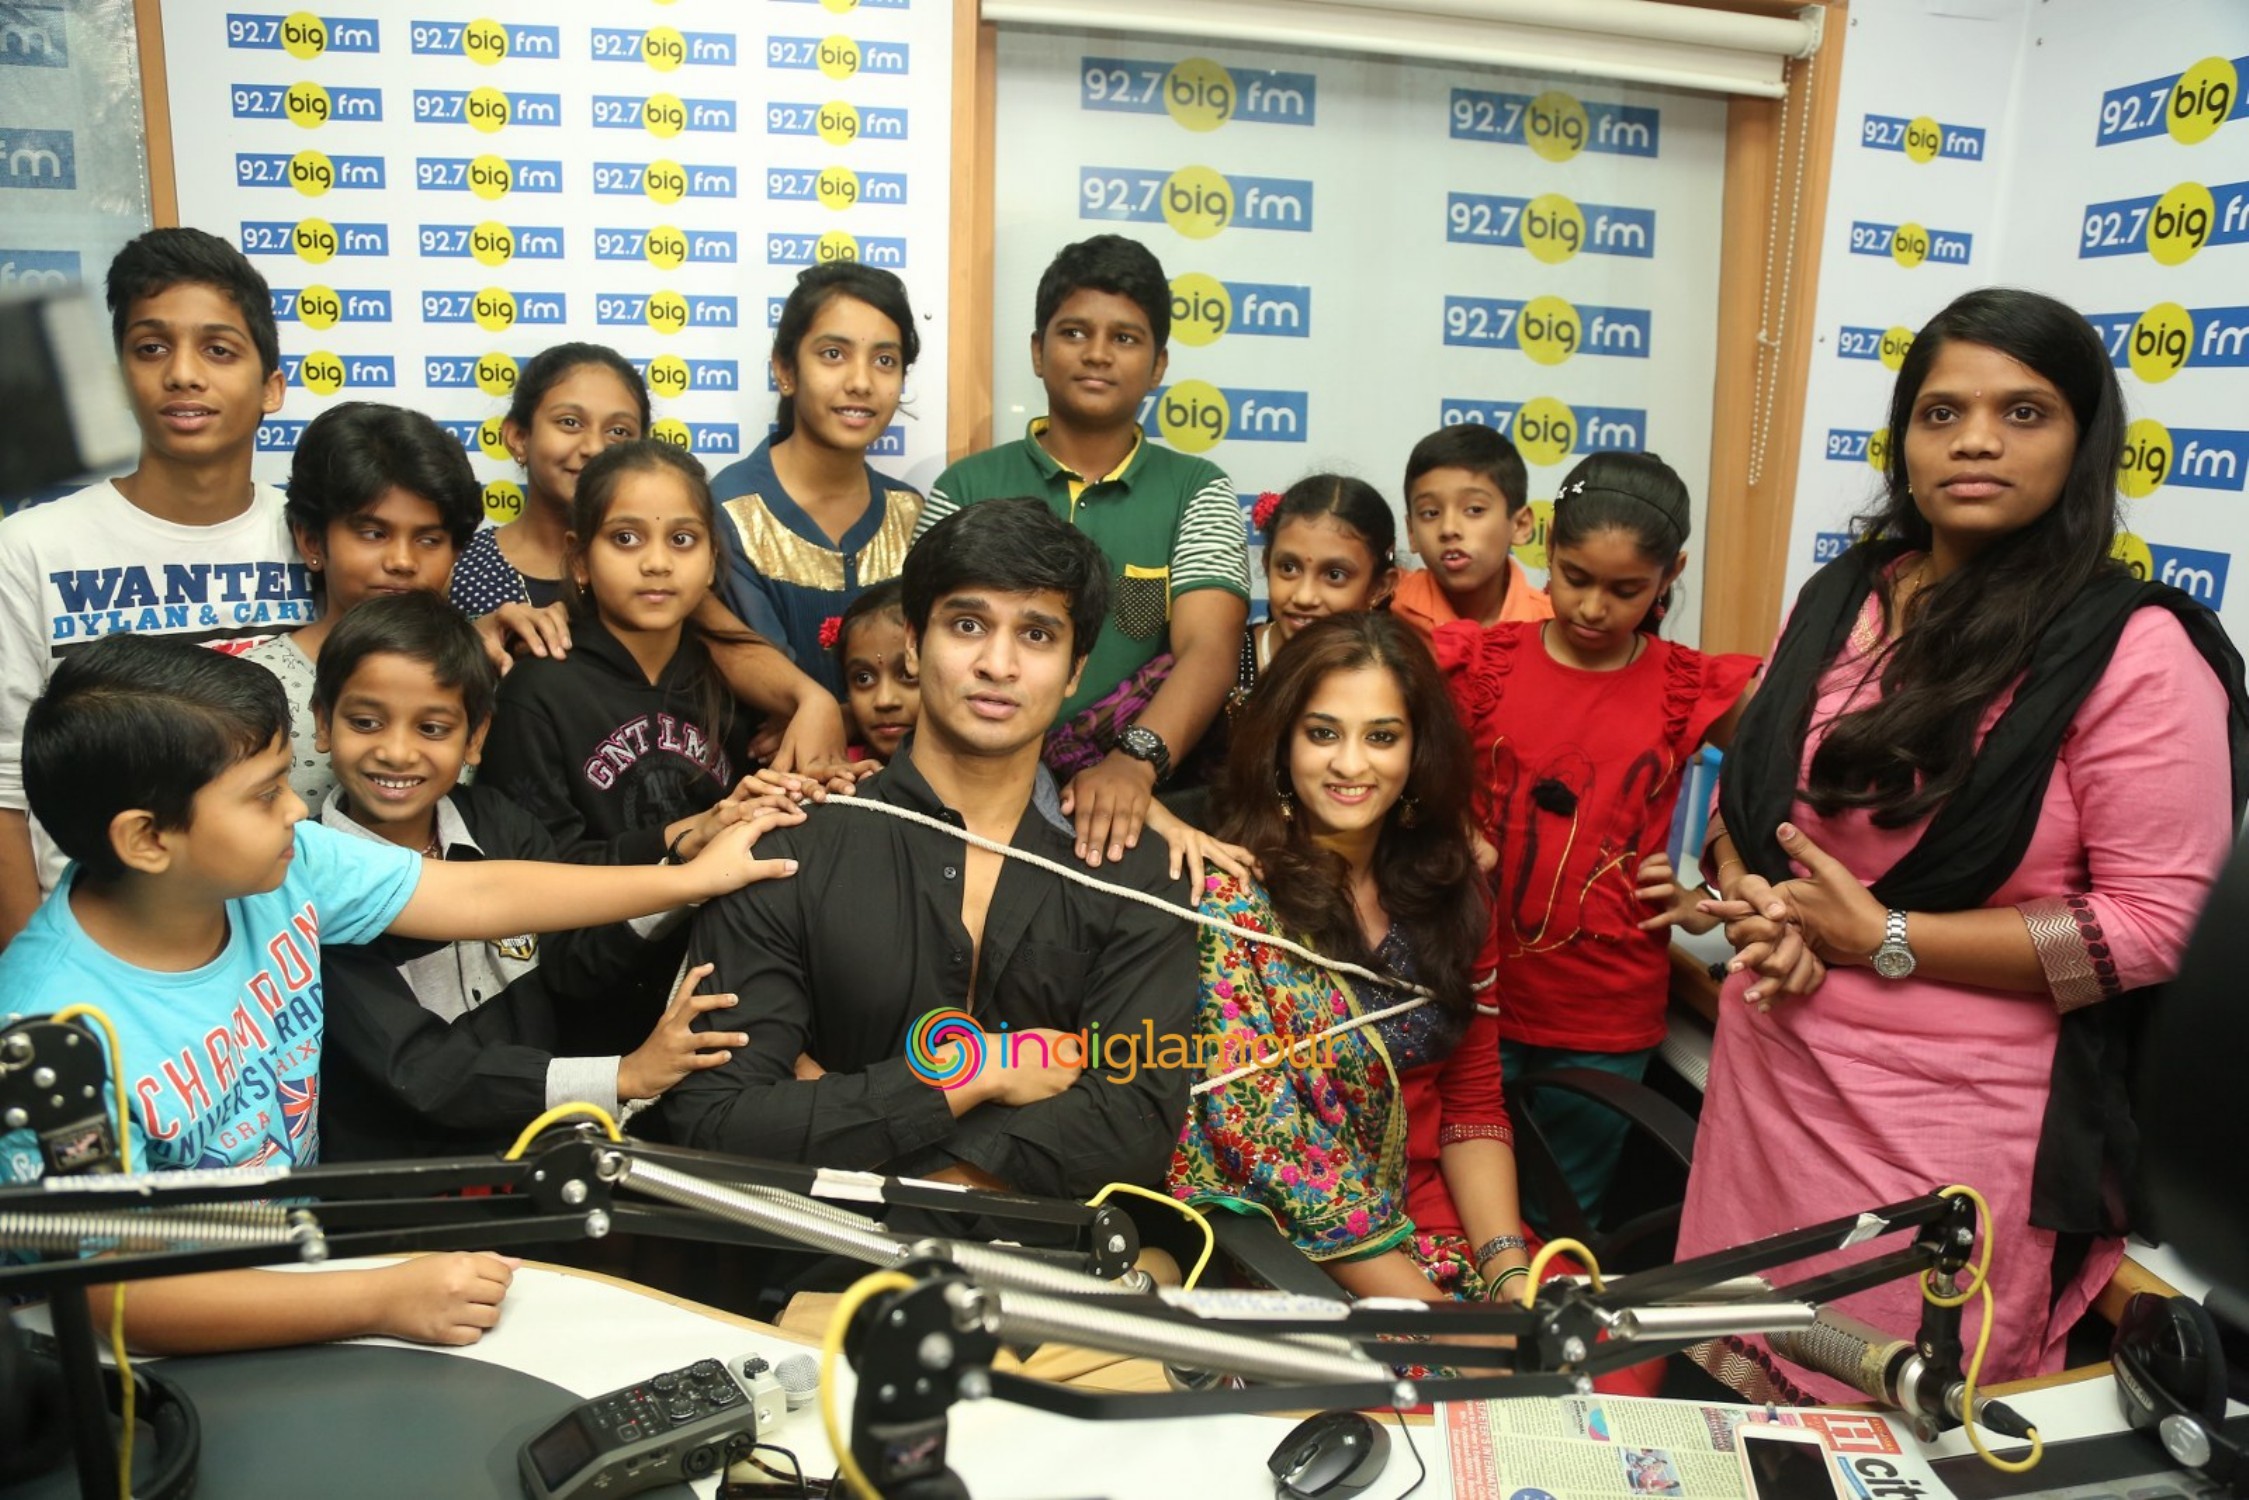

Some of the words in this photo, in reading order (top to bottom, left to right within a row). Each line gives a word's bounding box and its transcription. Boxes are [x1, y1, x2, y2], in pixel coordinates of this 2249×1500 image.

[231, 21, 281, 42] 92.7
[285, 23, 323, 51] big
[335, 25, 372, 45] fm
[414, 28, 462, 48] 92.7
[468, 30, 504, 56] big
[515, 32, 552, 52] fm
[594, 34, 640, 55] 92.7
[647, 38, 681, 63] big
[693, 39, 730, 59] fm
[770, 41, 815, 64] 92.7
[822, 47, 855, 71] big
[868, 48, 902, 67] fm
[236, 91, 284, 112] 92.7
[289, 93, 327, 120] big
[338, 94, 375, 114] fm
[1086, 69, 1161, 103] 92.7
[1172, 74, 1229, 119] big
[1248, 81, 1304, 115] fm
[2103, 88, 2169, 135] 92.7
[2174, 80, 2229, 124] big
[417, 96, 464, 117] 92.7
[470, 98, 506, 124] big
[517, 100, 554, 120] fm
[595, 102, 641, 122] 92.7
[648, 105, 682, 130] big
[694, 106, 730, 126] fm
[770, 108, 814, 130] 92.7
[822, 113, 855, 137] big
[866, 113, 901, 133] fm
[1454, 98, 1523, 133] 92.7
[1532, 107, 1582, 150] big
[1598, 113, 1649, 147] fm
[1865, 121, 1905, 144] 92.7
[1908, 127, 1938, 155] big
[1947, 132, 1979, 154] fm
[240, 160, 289, 180] 92.7
[293, 161, 330, 188] big
[341, 163, 378, 182] fm
[419, 164, 467, 184] 92.7
[472, 166, 508, 191] big
[519, 167, 556, 186] fm
[596, 169, 643, 189] 92.7
[649, 171, 683, 196] big
[694, 172, 730, 191] fm
[770, 173, 814, 195] 92.7
[821, 178, 854, 202] big
[866, 178, 900, 198] fm
[1083, 178, 1160, 212] 92.7
[1170, 182, 1227, 227] big
[1245, 187, 1301, 221] fm
[1451, 202, 1521, 236] 92.7
[1529, 210, 1578, 252] big
[1595, 215, 1645, 248] fm
[2085, 208, 2149, 248] 92.7
[2154, 203, 2207, 248] big
[245, 228, 293, 248] 92.7
[297, 229, 334, 255] big
[345, 230, 381, 249] fm
[422, 231, 469, 251] 92.7
[475, 233, 510, 258] big
[521, 233, 557, 252] fm
[597, 235, 643, 254] 92.7
[649, 237, 684, 261] big
[695, 238, 730, 256] fm
[769, 239, 814, 260] 92.7
[865, 243, 900, 263] fm
[1853, 228, 1892, 250] 92.7
[1896, 233, 1926, 260] big
[1934, 237, 1965, 258] fm
[301, 296, 338, 322] big
[348, 297, 384, 315] fm
[425, 297, 472, 316] 92.7
[477, 298, 512, 323] big
[524, 299, 559, 318] fm
[598, 300, 645, 319] 92.7
[651, 302, 685, 326] big
[696, 301, 731, 320] fm
[1243, 294, 1299, 327] fm
[1449, 305, 1517, 338] 92.7
[1525, 312, 1574, 352] big
[1590, 316, 1641, 348] fm
[1841, 333, 1880, 354] 92.7
[2135, 322, 2186, 368] big
[305, 362, 342, 387] big
[352, 362, 388, 381] fm
[427, 362, 474, 382] 92.7
[480, 363, 515, 388] big
[652, 366, 687, 391] big
[697, 366, 731, 384] fm
[1166, 397, 1222, 440] big
[1240, 400, 1296, 432] fm
[257, 427, 304, 446] 92.7
[698, 429, 733, 448] fm
[1521, 413, 1571, 454] big
[1587, 416, 1636, 448] fm
[1829, 436, 1867, 455] 92.7
[2180, 441, 2236, 478] fm
[486, 490, 521, 515] big
[53, 606, 188, 639] DYLAN
[199, 604, 219, 625] &
[584, 715, 650, 790] GNT
[1823, 1416, 1884, 1450] H
